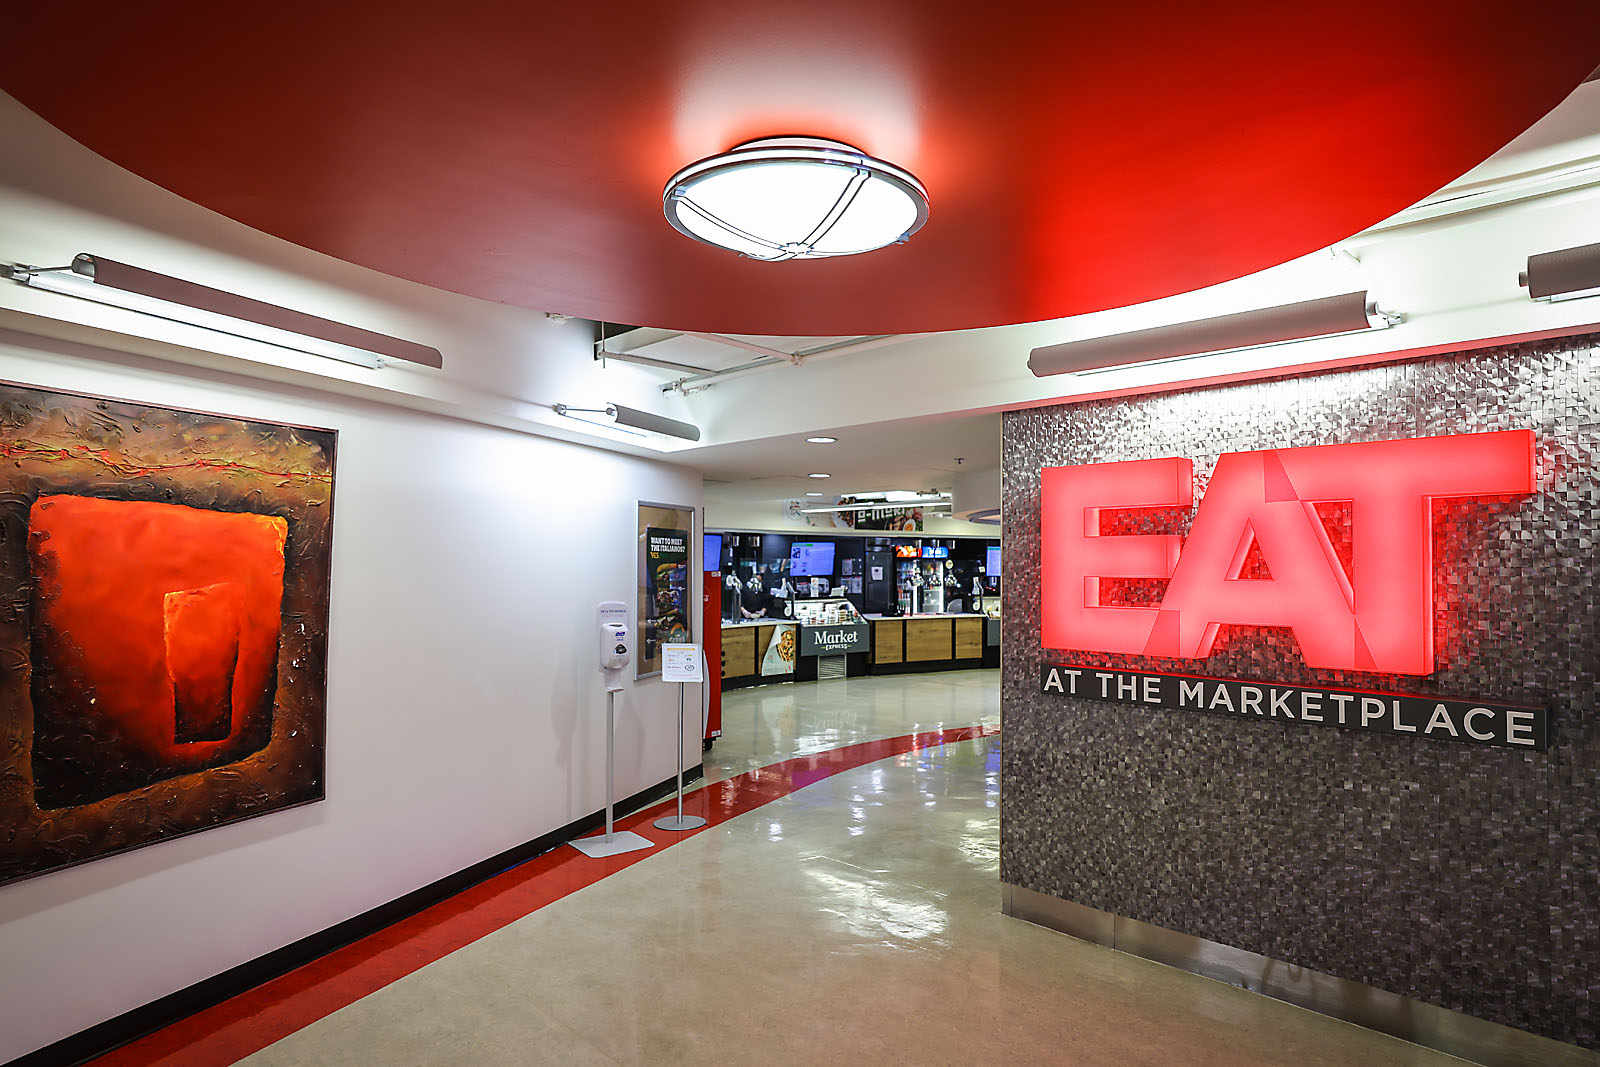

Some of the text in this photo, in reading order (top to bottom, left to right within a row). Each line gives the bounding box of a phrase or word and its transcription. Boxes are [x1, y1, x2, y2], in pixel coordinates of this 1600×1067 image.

[650, 536, 664, 545] WANT
[664, 537, 671, 545] TO
[650, 544, 660, 552] THE
[650, 551, 659, 559] YES
[1041, 429, 1536, 677] EAT
[814, 629, 859, 645] Market
[825, 643, 848, 651] EXPRESS
[1043, 668, 1535, 746] AT THE MARKETPLACE
